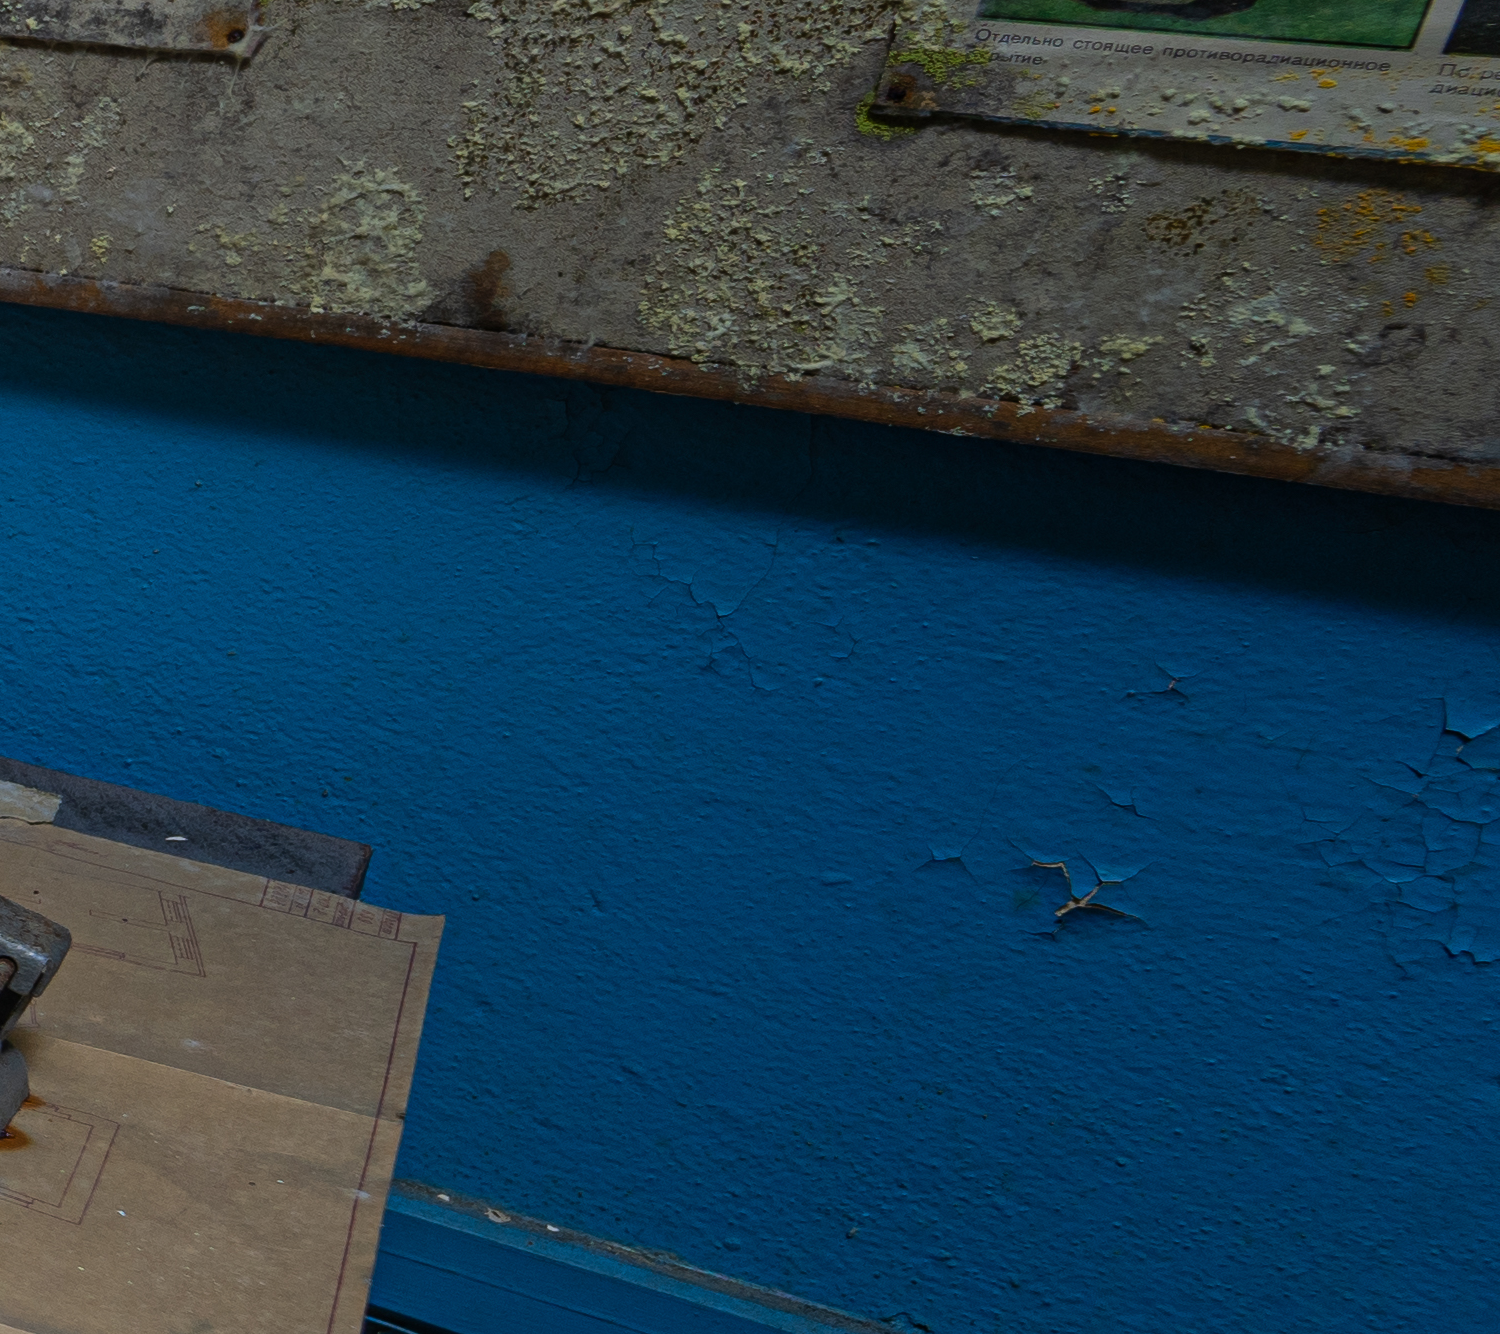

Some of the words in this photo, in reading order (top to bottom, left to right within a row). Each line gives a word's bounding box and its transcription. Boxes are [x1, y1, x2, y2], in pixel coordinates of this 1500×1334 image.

[974, 27, 1066, 50] Отдельно
[1072, 38, 1154, 57] стоящее
[1162, 43, 1392, 73] противорадиационное
